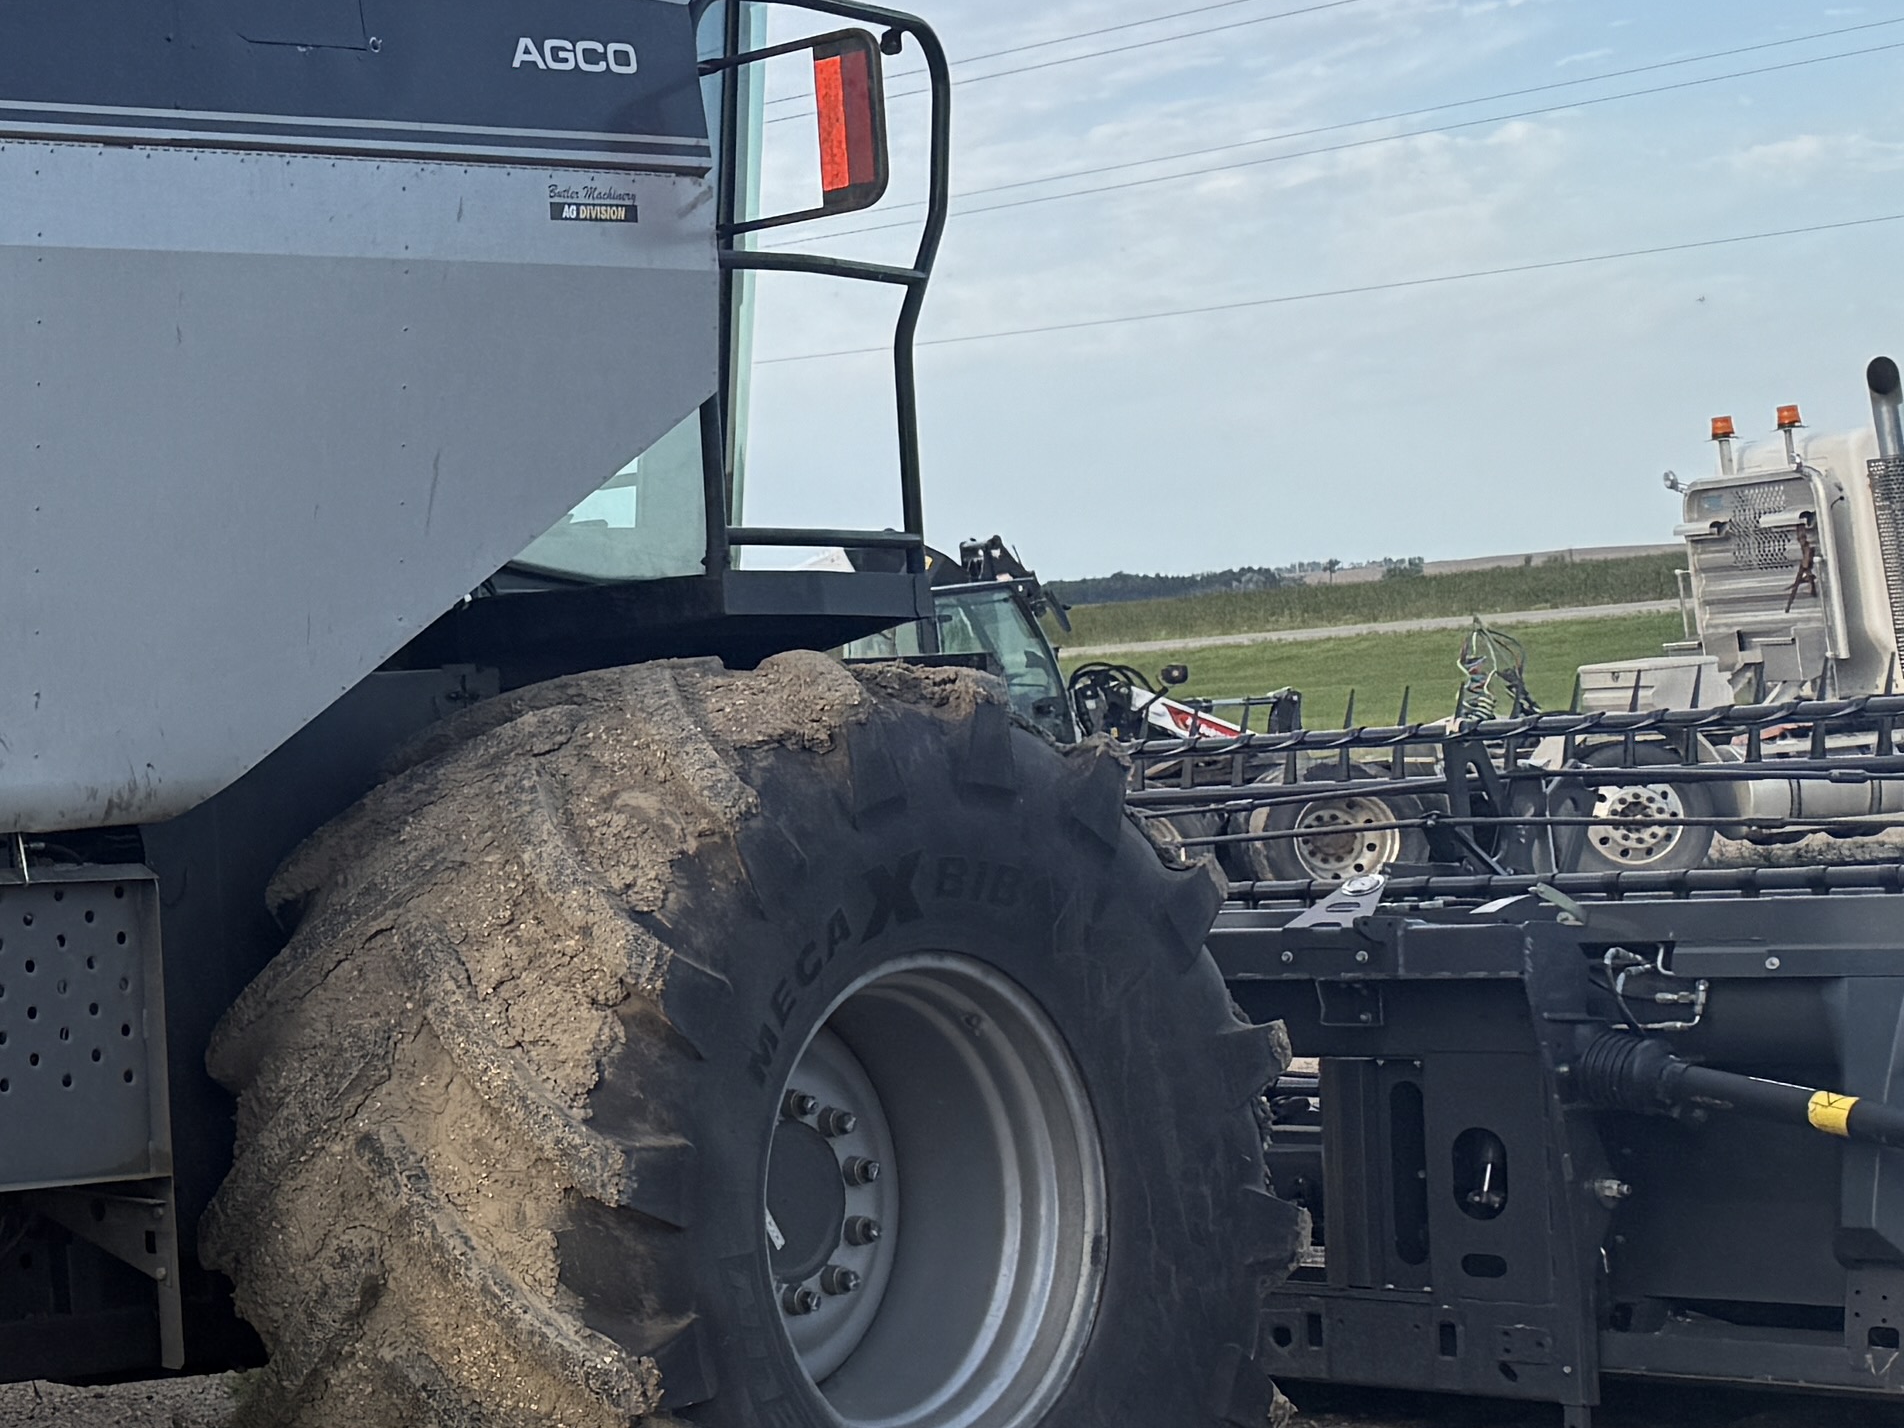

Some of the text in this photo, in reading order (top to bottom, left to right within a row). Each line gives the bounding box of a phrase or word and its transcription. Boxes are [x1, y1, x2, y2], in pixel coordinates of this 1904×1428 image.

[511, 36, 639, 75] AGCO
[548, 184, 638, 205] Butler Machinery
[562, 204, 626, 221] AG DIVISION
